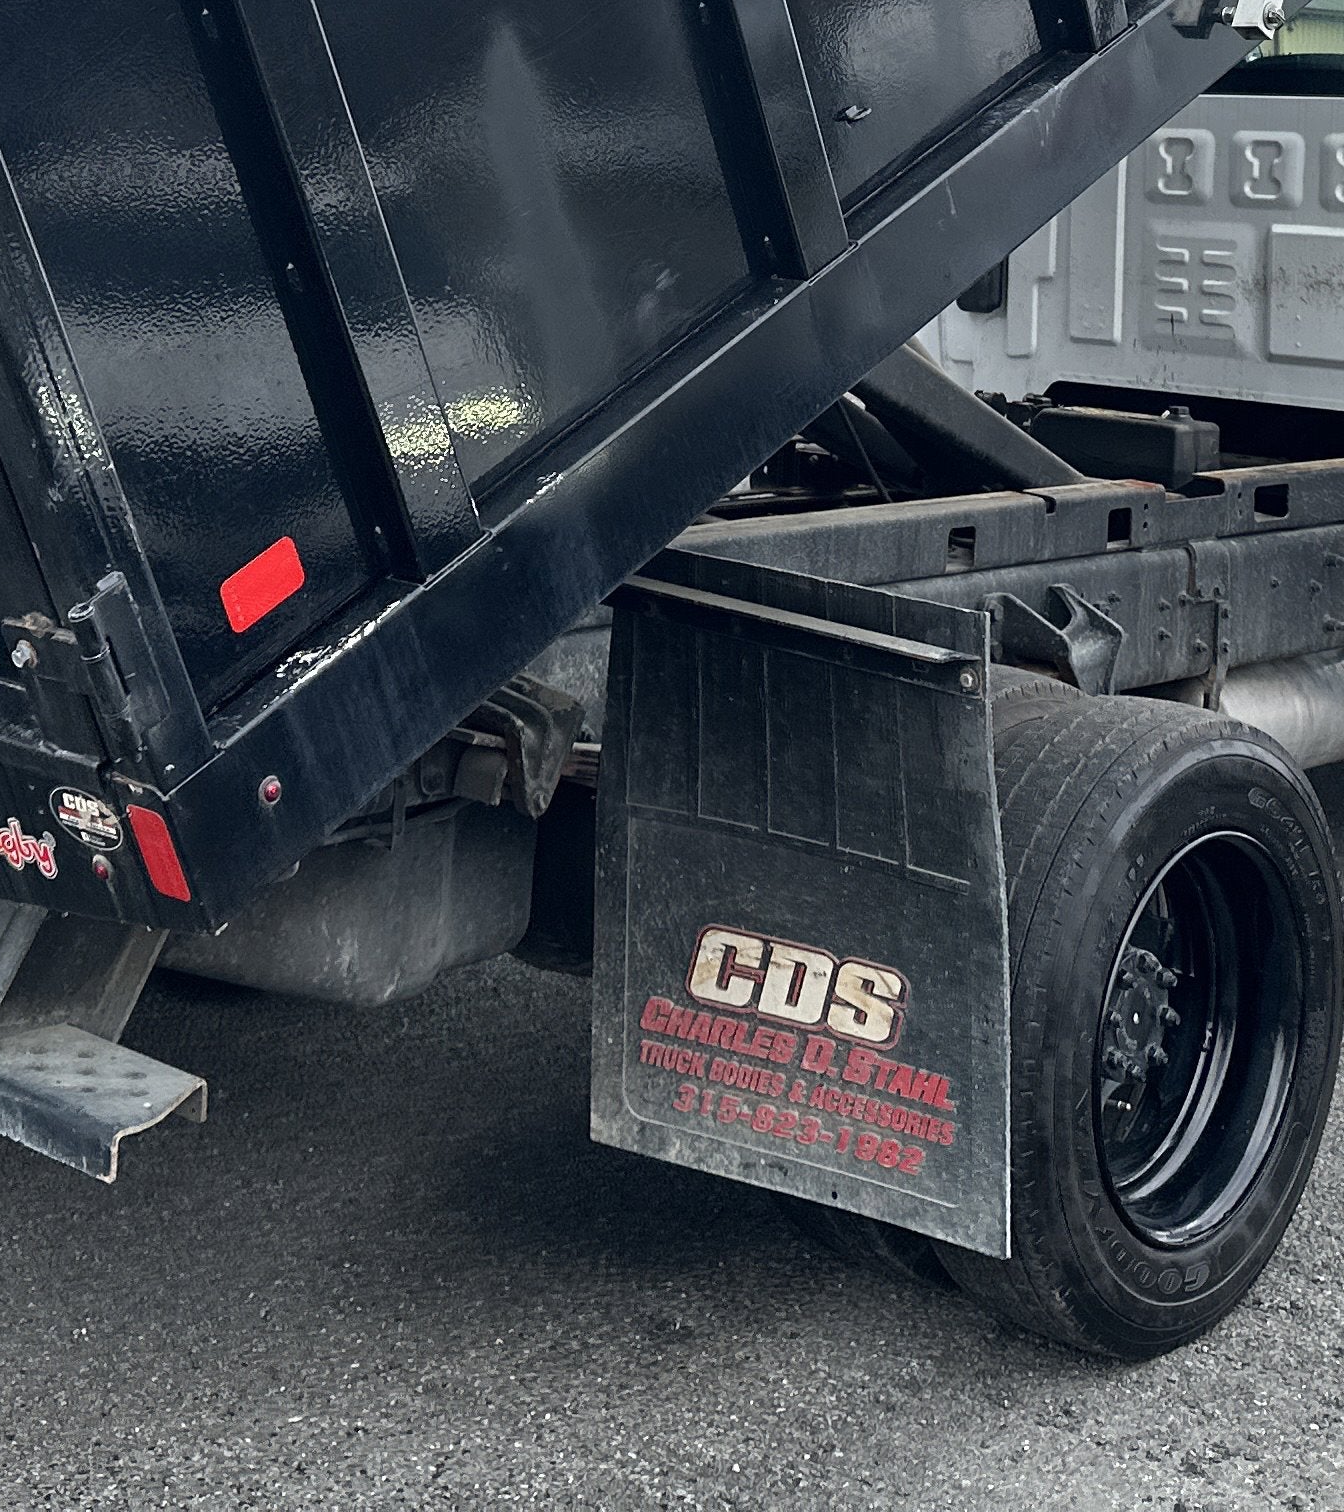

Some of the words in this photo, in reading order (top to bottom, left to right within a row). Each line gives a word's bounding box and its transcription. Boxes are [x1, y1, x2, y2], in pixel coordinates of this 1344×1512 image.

[687, 925, 908, 1048] CDS
[640, 996, 797, 1064] CHARLES
[800, 1034, 839, 1079] D.
[842, 1047, 956, 1111] STAHL
[640, 1039, 708, 1078] TRUCK
[709, 1056, 787, 1097] BODIES
[787, 1079, 807, 1104] &
[809, 1083, 956, 1146] ACCESSORIES
[673, 1083, 927, 1176] 315-823-1982
